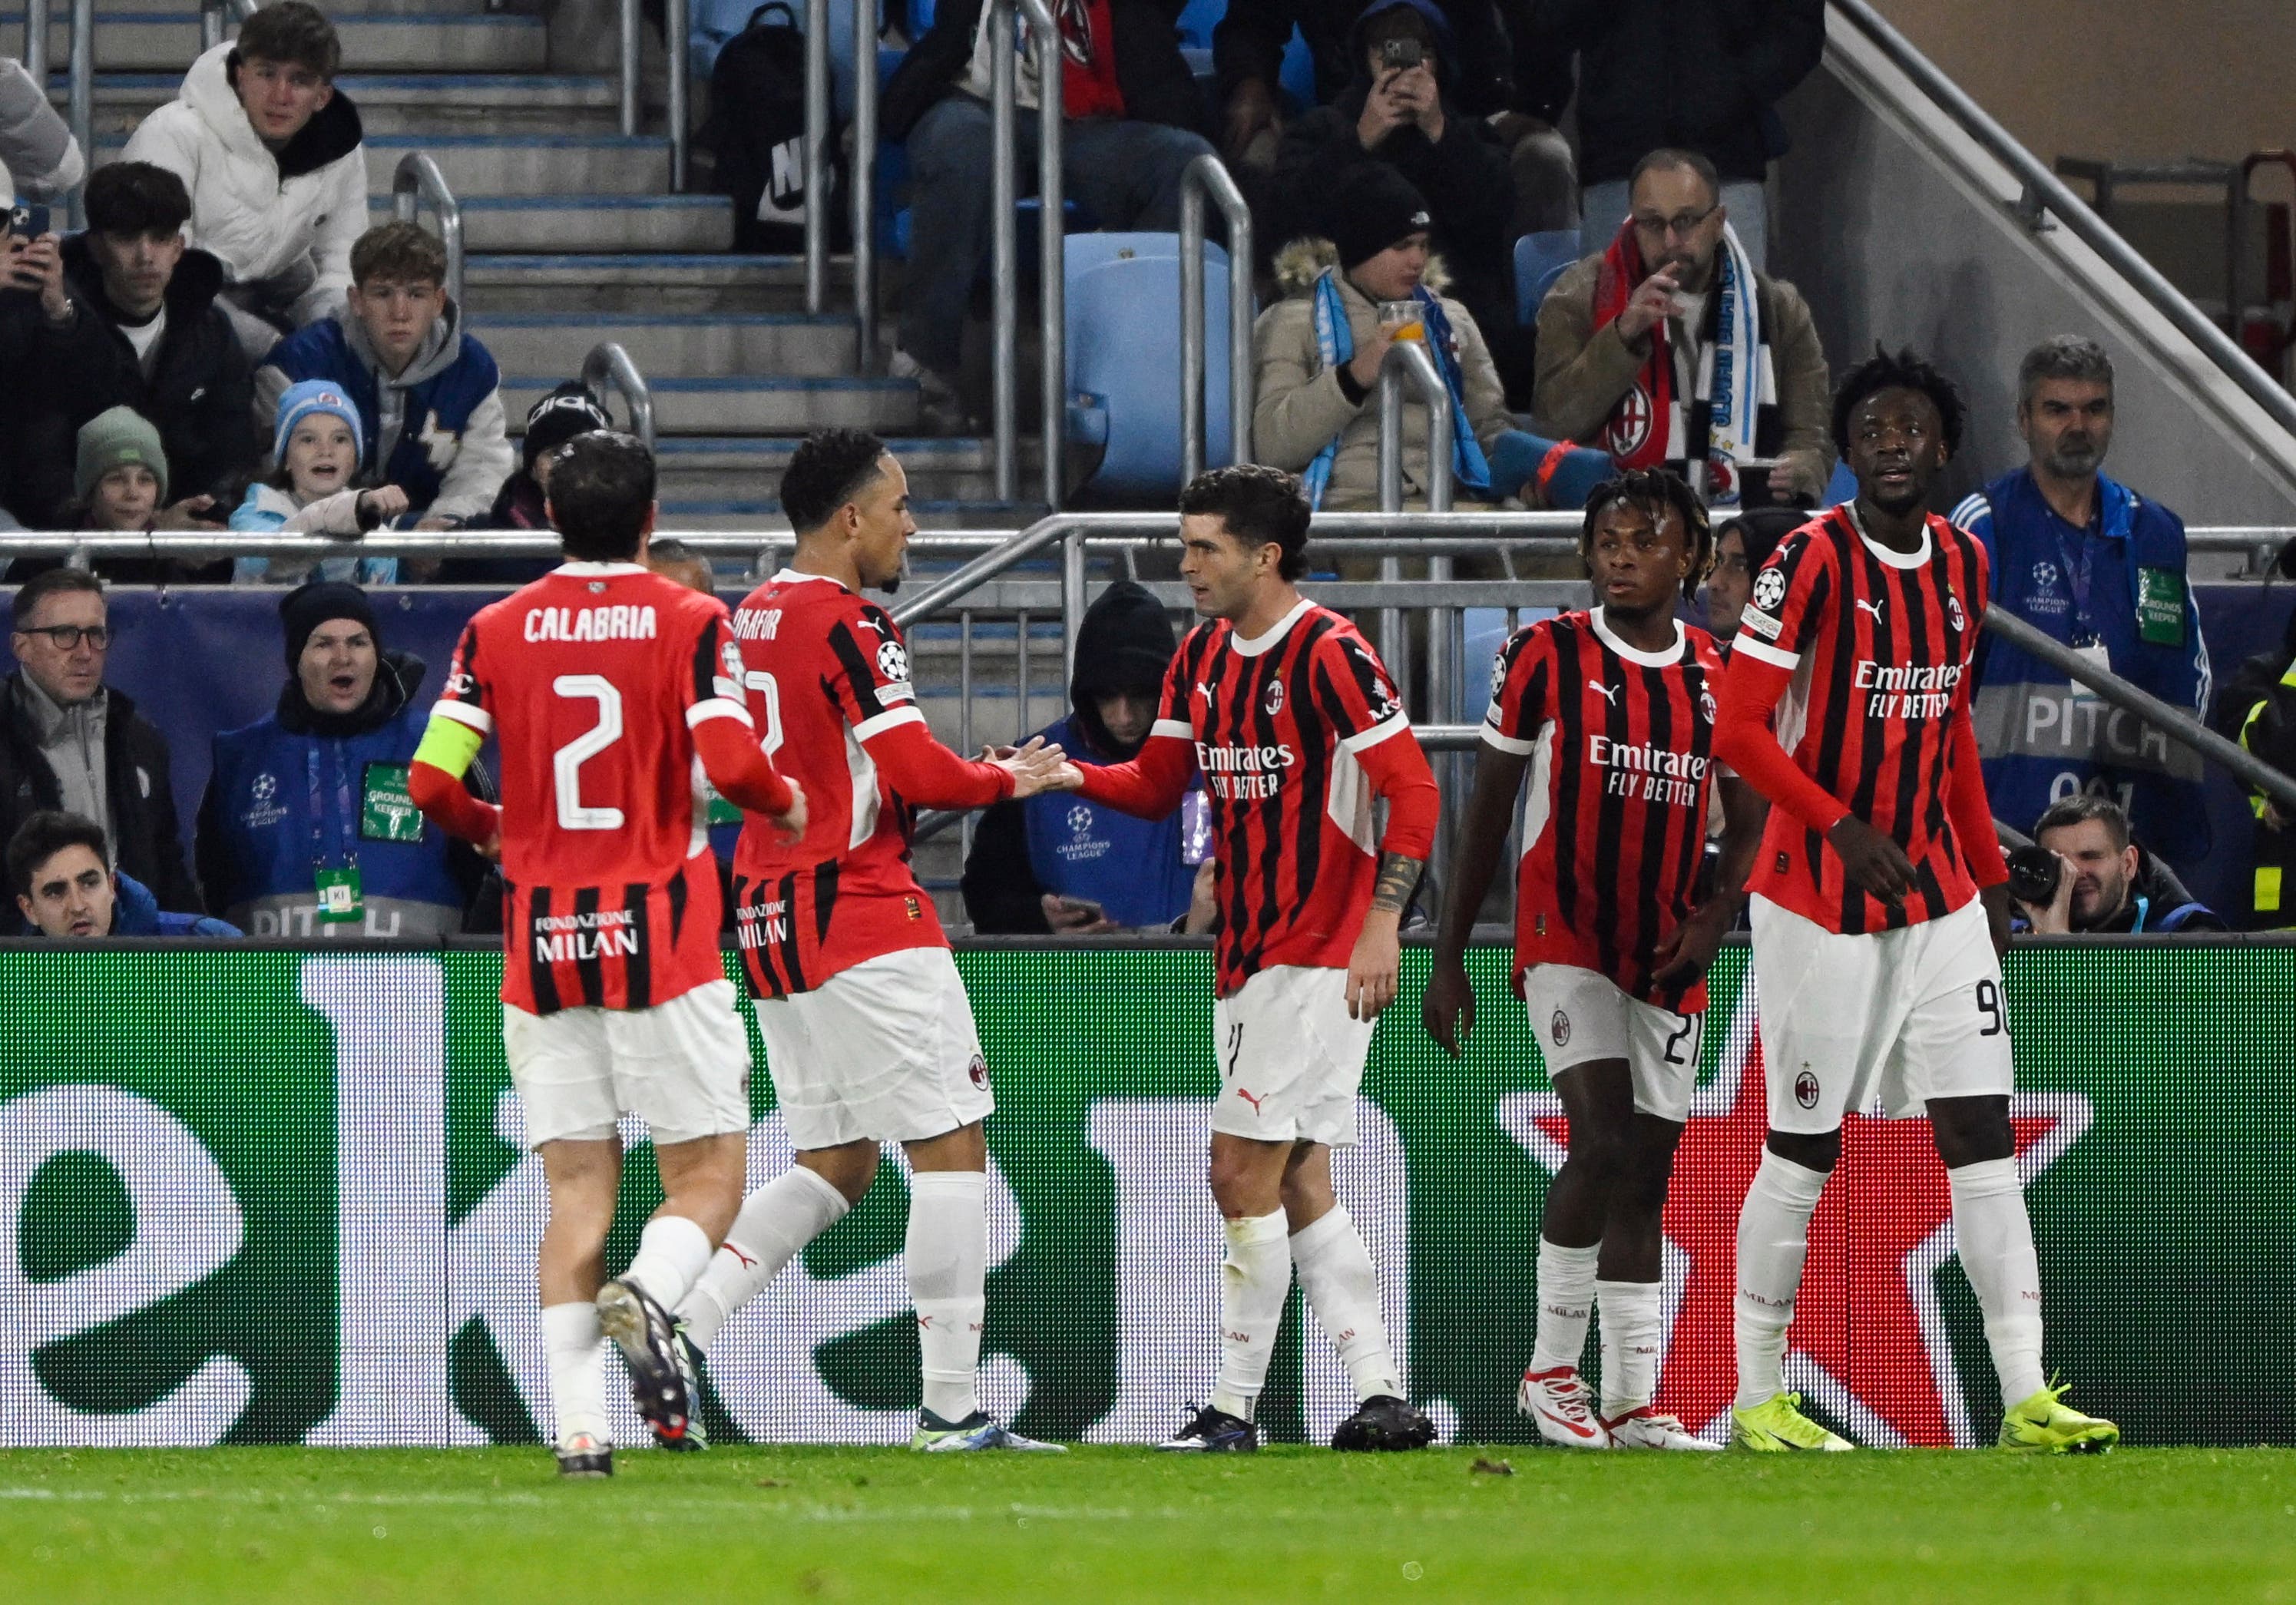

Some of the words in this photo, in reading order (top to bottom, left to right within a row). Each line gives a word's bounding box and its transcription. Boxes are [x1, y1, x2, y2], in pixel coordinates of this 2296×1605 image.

[524, 605, 657, 644] CALABRIA
[733, 607, 783, 640] OKAFOR
[1855, 660, 1965, 690] Emirates
[1868, 693, 1899, 719] FLY
[1901, 693, 1949, 719] BETTER
[2026, 695, 2168, 763] PITCH
[552, 674, 626, 830] 2
[1195, 740, 1295, 771] Emirates
[1590, 734, 1711, 781] Emirate
[1211, 775, 1229, 799] FLY
[1232, 773, 1279, 799] BETTER
[1608, 771, 1639, 797] FLY
[1643, 776, 1696, 807] BETTER
[535, 909, 634, 932] FONDAZIONE
[737, 918, 787, 949] MILAN
[536, 928, 639, 963] MILAN
[1664, 1011, 1702, 1067] 21
